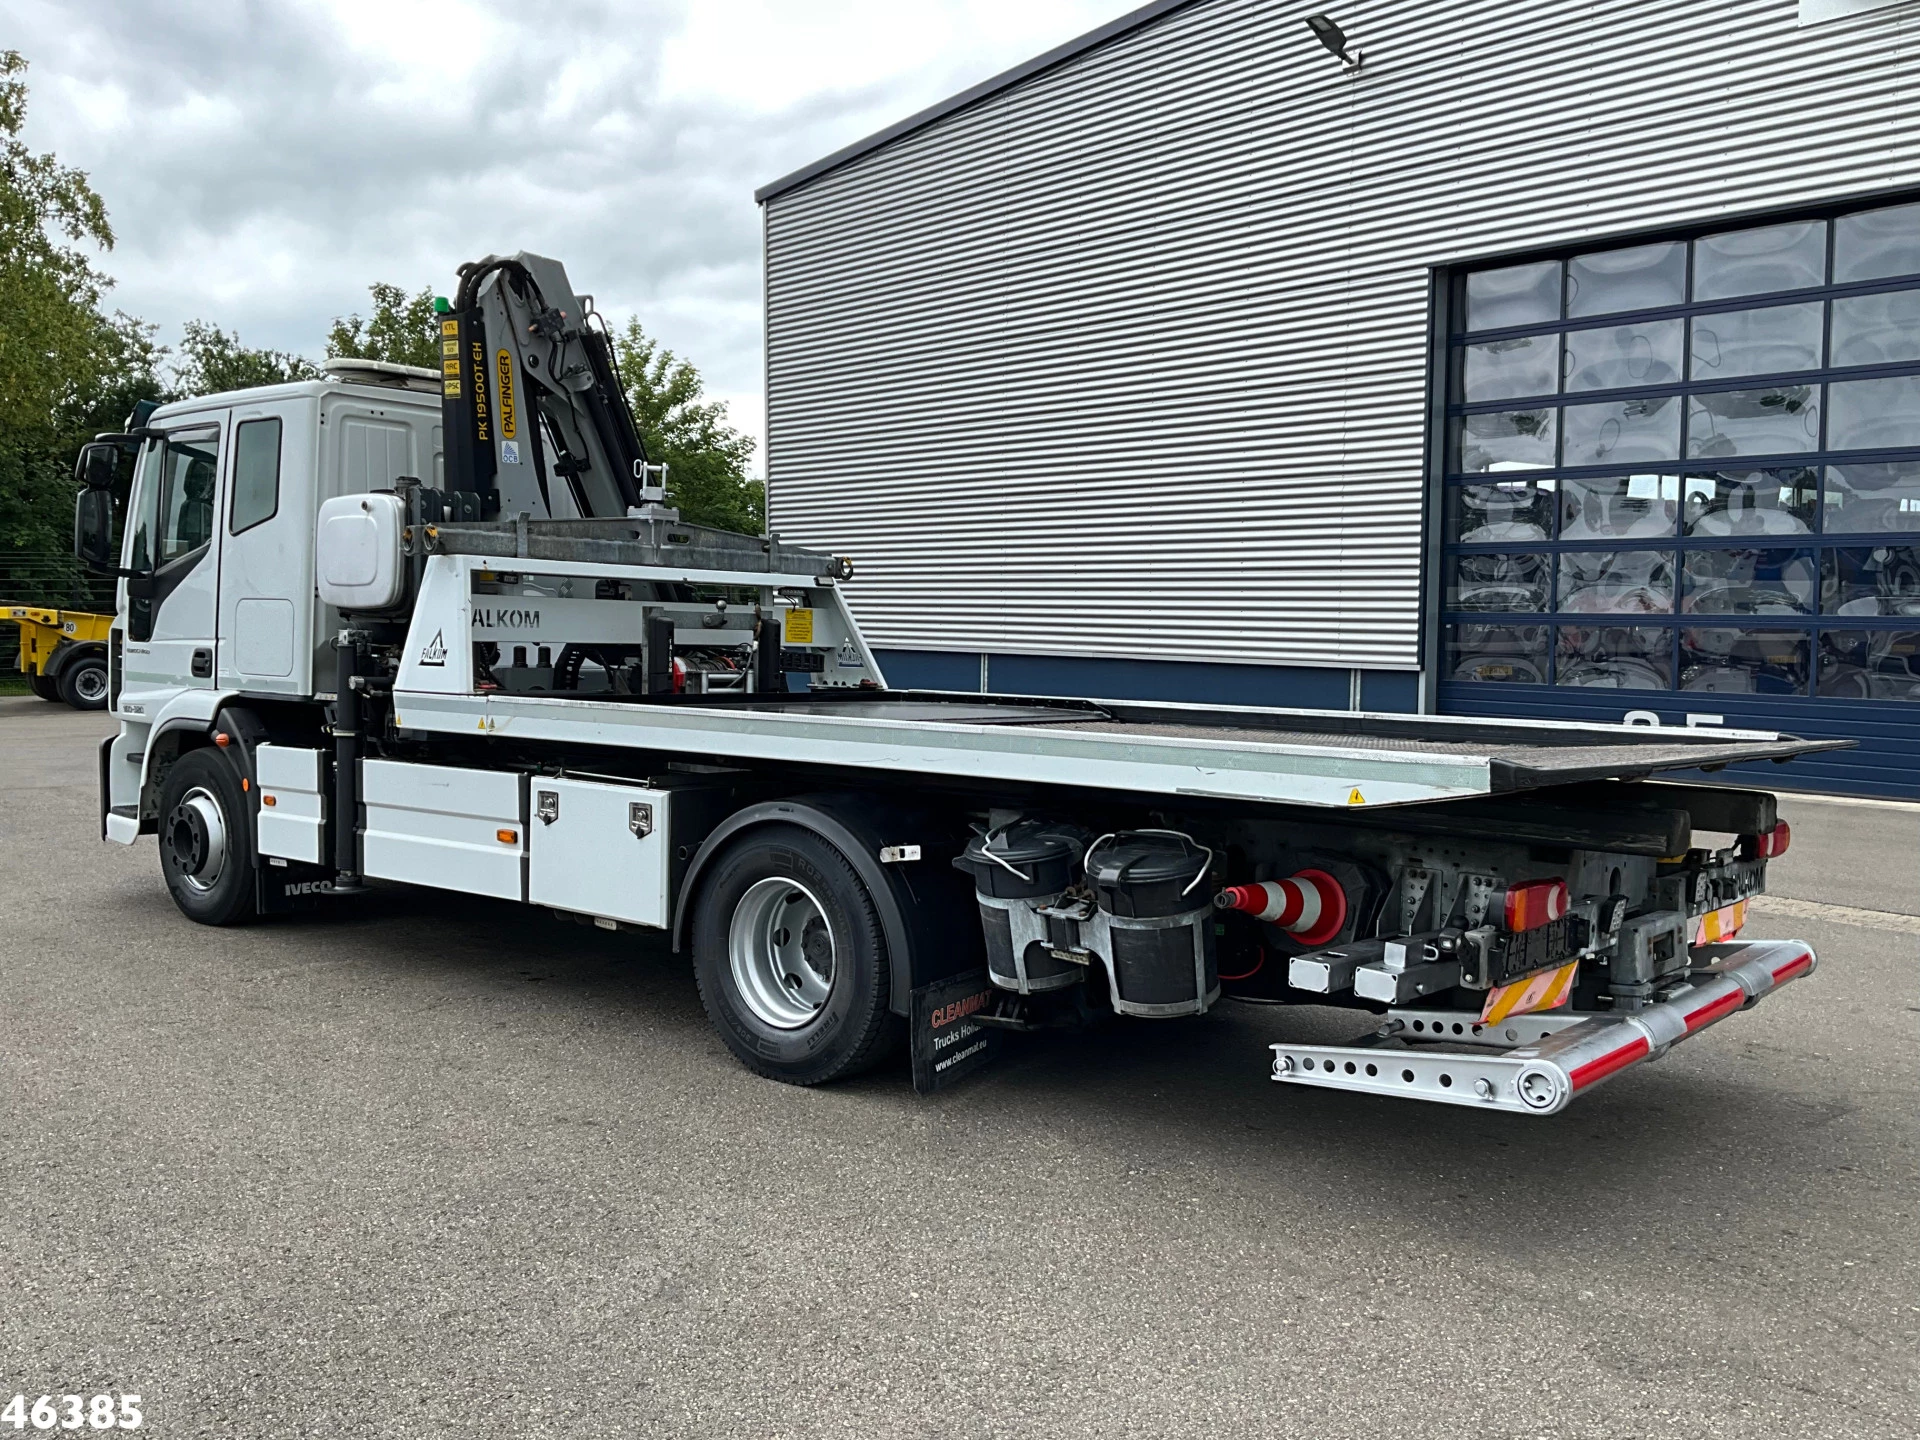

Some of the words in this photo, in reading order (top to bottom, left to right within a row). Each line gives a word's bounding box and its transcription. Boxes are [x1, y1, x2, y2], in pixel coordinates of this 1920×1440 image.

[500, 355, 514, 433] PALFINGER
[477, 421, 488, 440] PK
[503, 454, 518, 463] OCB
[65, 623, 75, 632] 80
[472, 608, 540, 628] ALKOM
[285, 880, 332, 896] IVECO
[931, 989, 992, 1028] CLEANMAT
[933, 1030, 959, 1050] Trucks
[960, 1021, 984, 1038] Holla
[935, 1039, 987, 1072] www.cleanmat.eu
